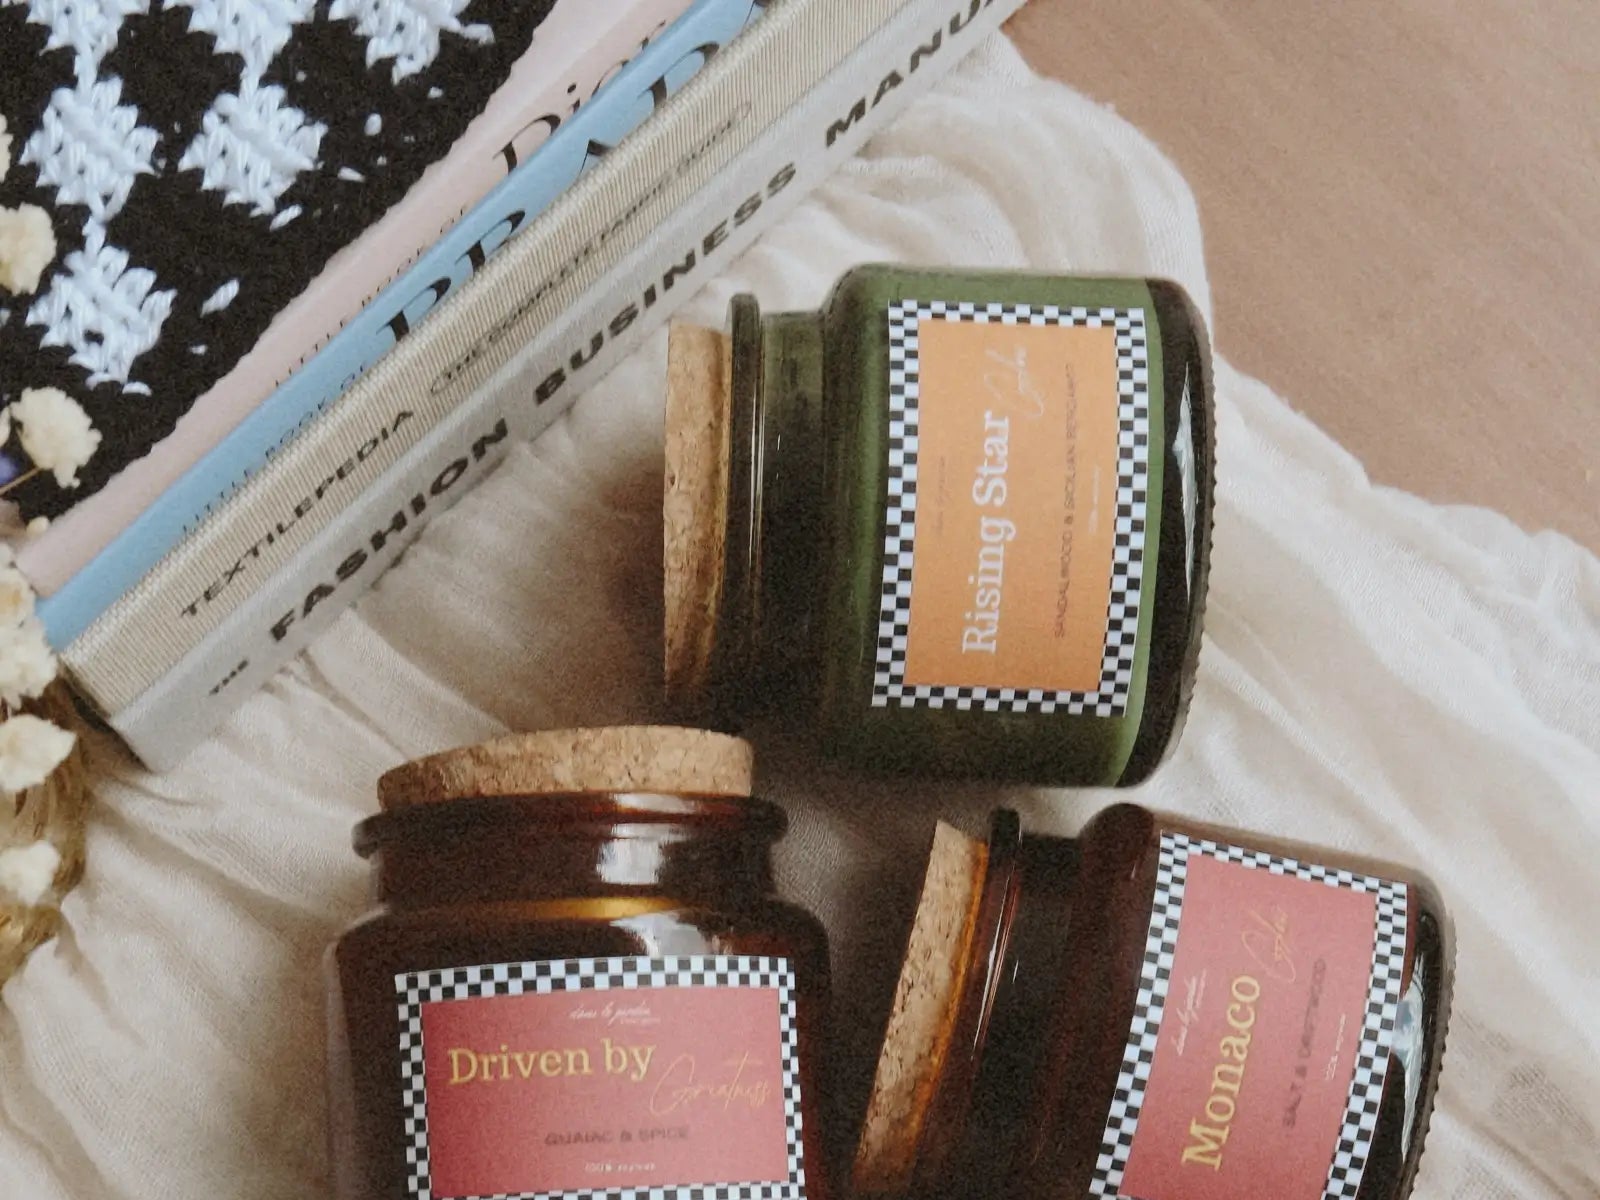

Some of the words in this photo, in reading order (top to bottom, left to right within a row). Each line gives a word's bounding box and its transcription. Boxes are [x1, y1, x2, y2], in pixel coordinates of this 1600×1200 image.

[270, 417, 508, 643] FASHION
[533, 162, 796, 407] BUSINESS
[826, 0, 994, 149] MANU
[181, 410, 413, 617] TEXTILEPEDIA
[971, 409, 1010, 506] Star
[961, 515, 1017, 656] Rising
[449, 1044, 594, 1085] Driven
[602, 1037, 657, 1083] by
[1181, 973, 1261, 1172] Monaco
